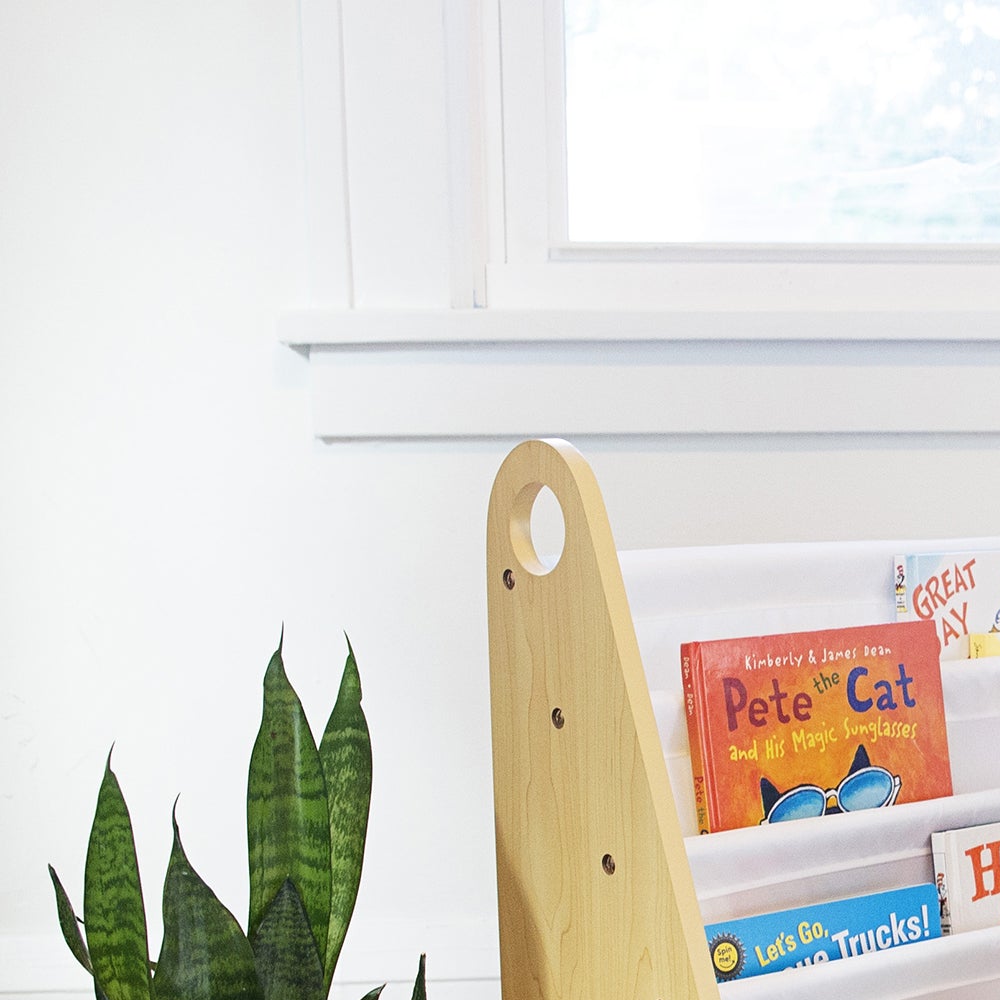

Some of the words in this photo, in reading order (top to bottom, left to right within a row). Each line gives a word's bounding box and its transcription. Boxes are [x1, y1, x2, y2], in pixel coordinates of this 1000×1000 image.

[912, 558, 976, 620] GREAT
[942, 602, 968, 646] AY
[745, 653, 803, 671] Kimberly
[808, 650, 817, 665] &
[821, 648, 857, 663] James
[864, 646, 891, 657] Dean
[722, 677, 813, 732] Pete
[813, 672, 840, 694] the
[847, 664, 917, 713] Cat
[729, 740, 758, 761] and
[765, 735, 785, 760] His
[791, 722, 838, 753] Magic
[843, 716, 918, 743] Sunglasses
[717, 945, 732, 956] Spin
[754, 932, 797, 967] Let's
[797, 921, 829, 945] Go,
[831, 904, 930, 960] Trucks!
[718, 954, 731, 963] me!
